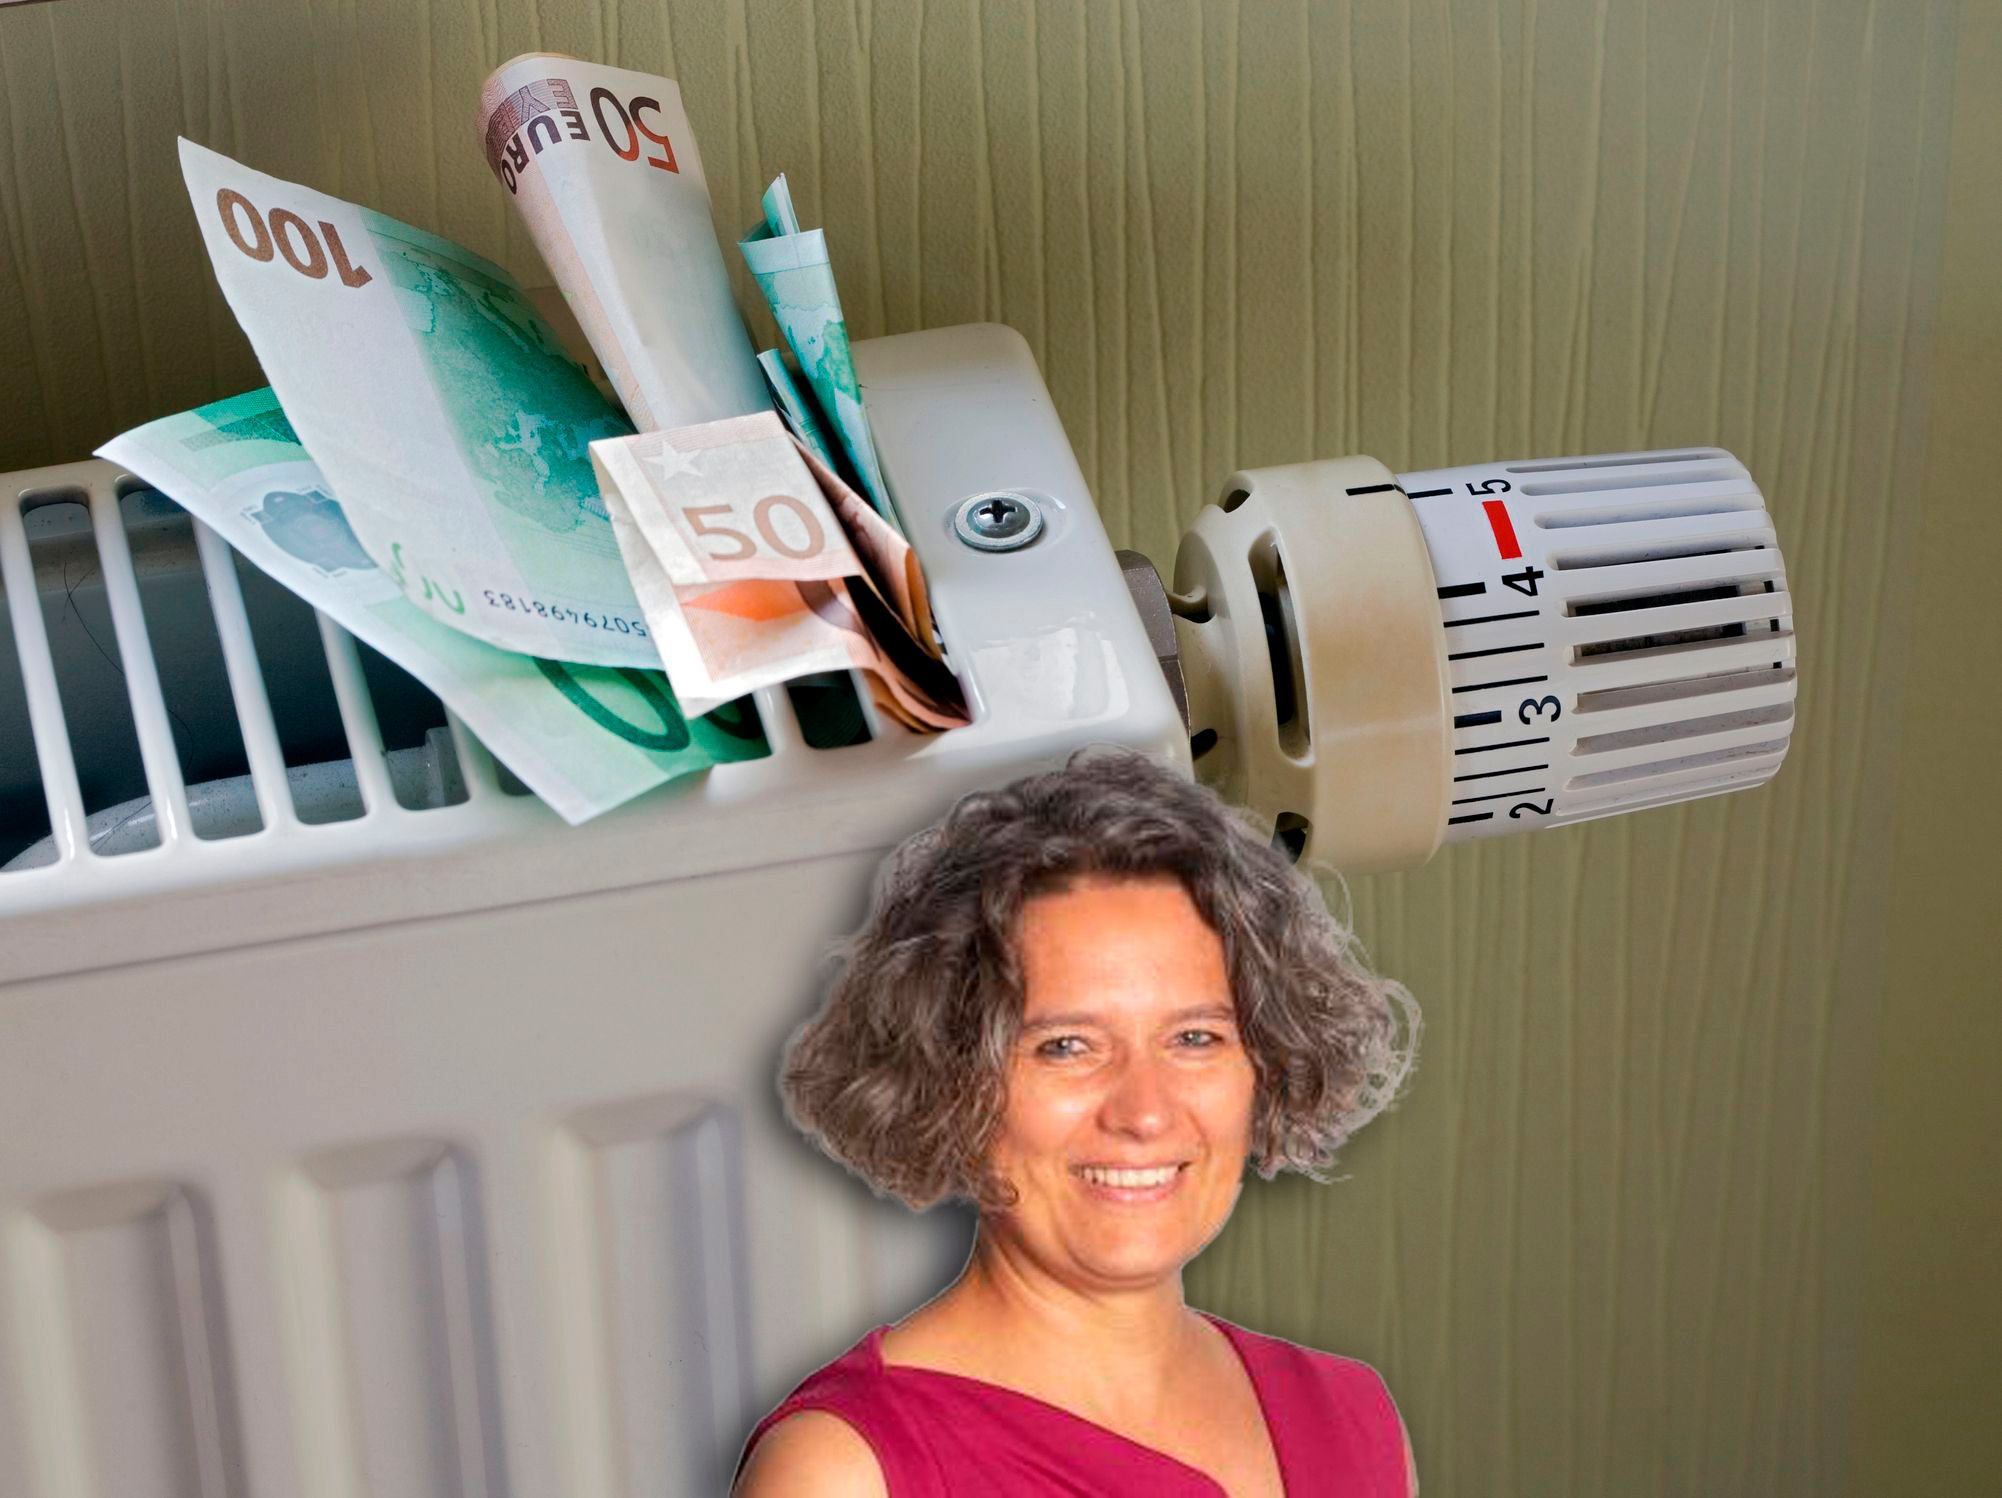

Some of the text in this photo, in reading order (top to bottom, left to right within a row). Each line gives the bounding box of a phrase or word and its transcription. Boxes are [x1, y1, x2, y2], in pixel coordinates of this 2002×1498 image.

[501, 87, 680, 195] 50 EURO
[216, 188, 373, 288] 100
[1465, 479, 1511, 496] 5
[681, 494, 826, 561] 50
[1501, 566, 1544, 596] 4
[1518, 695, 1561, 725] 3
[1509, 798, 1554, 819] 2
